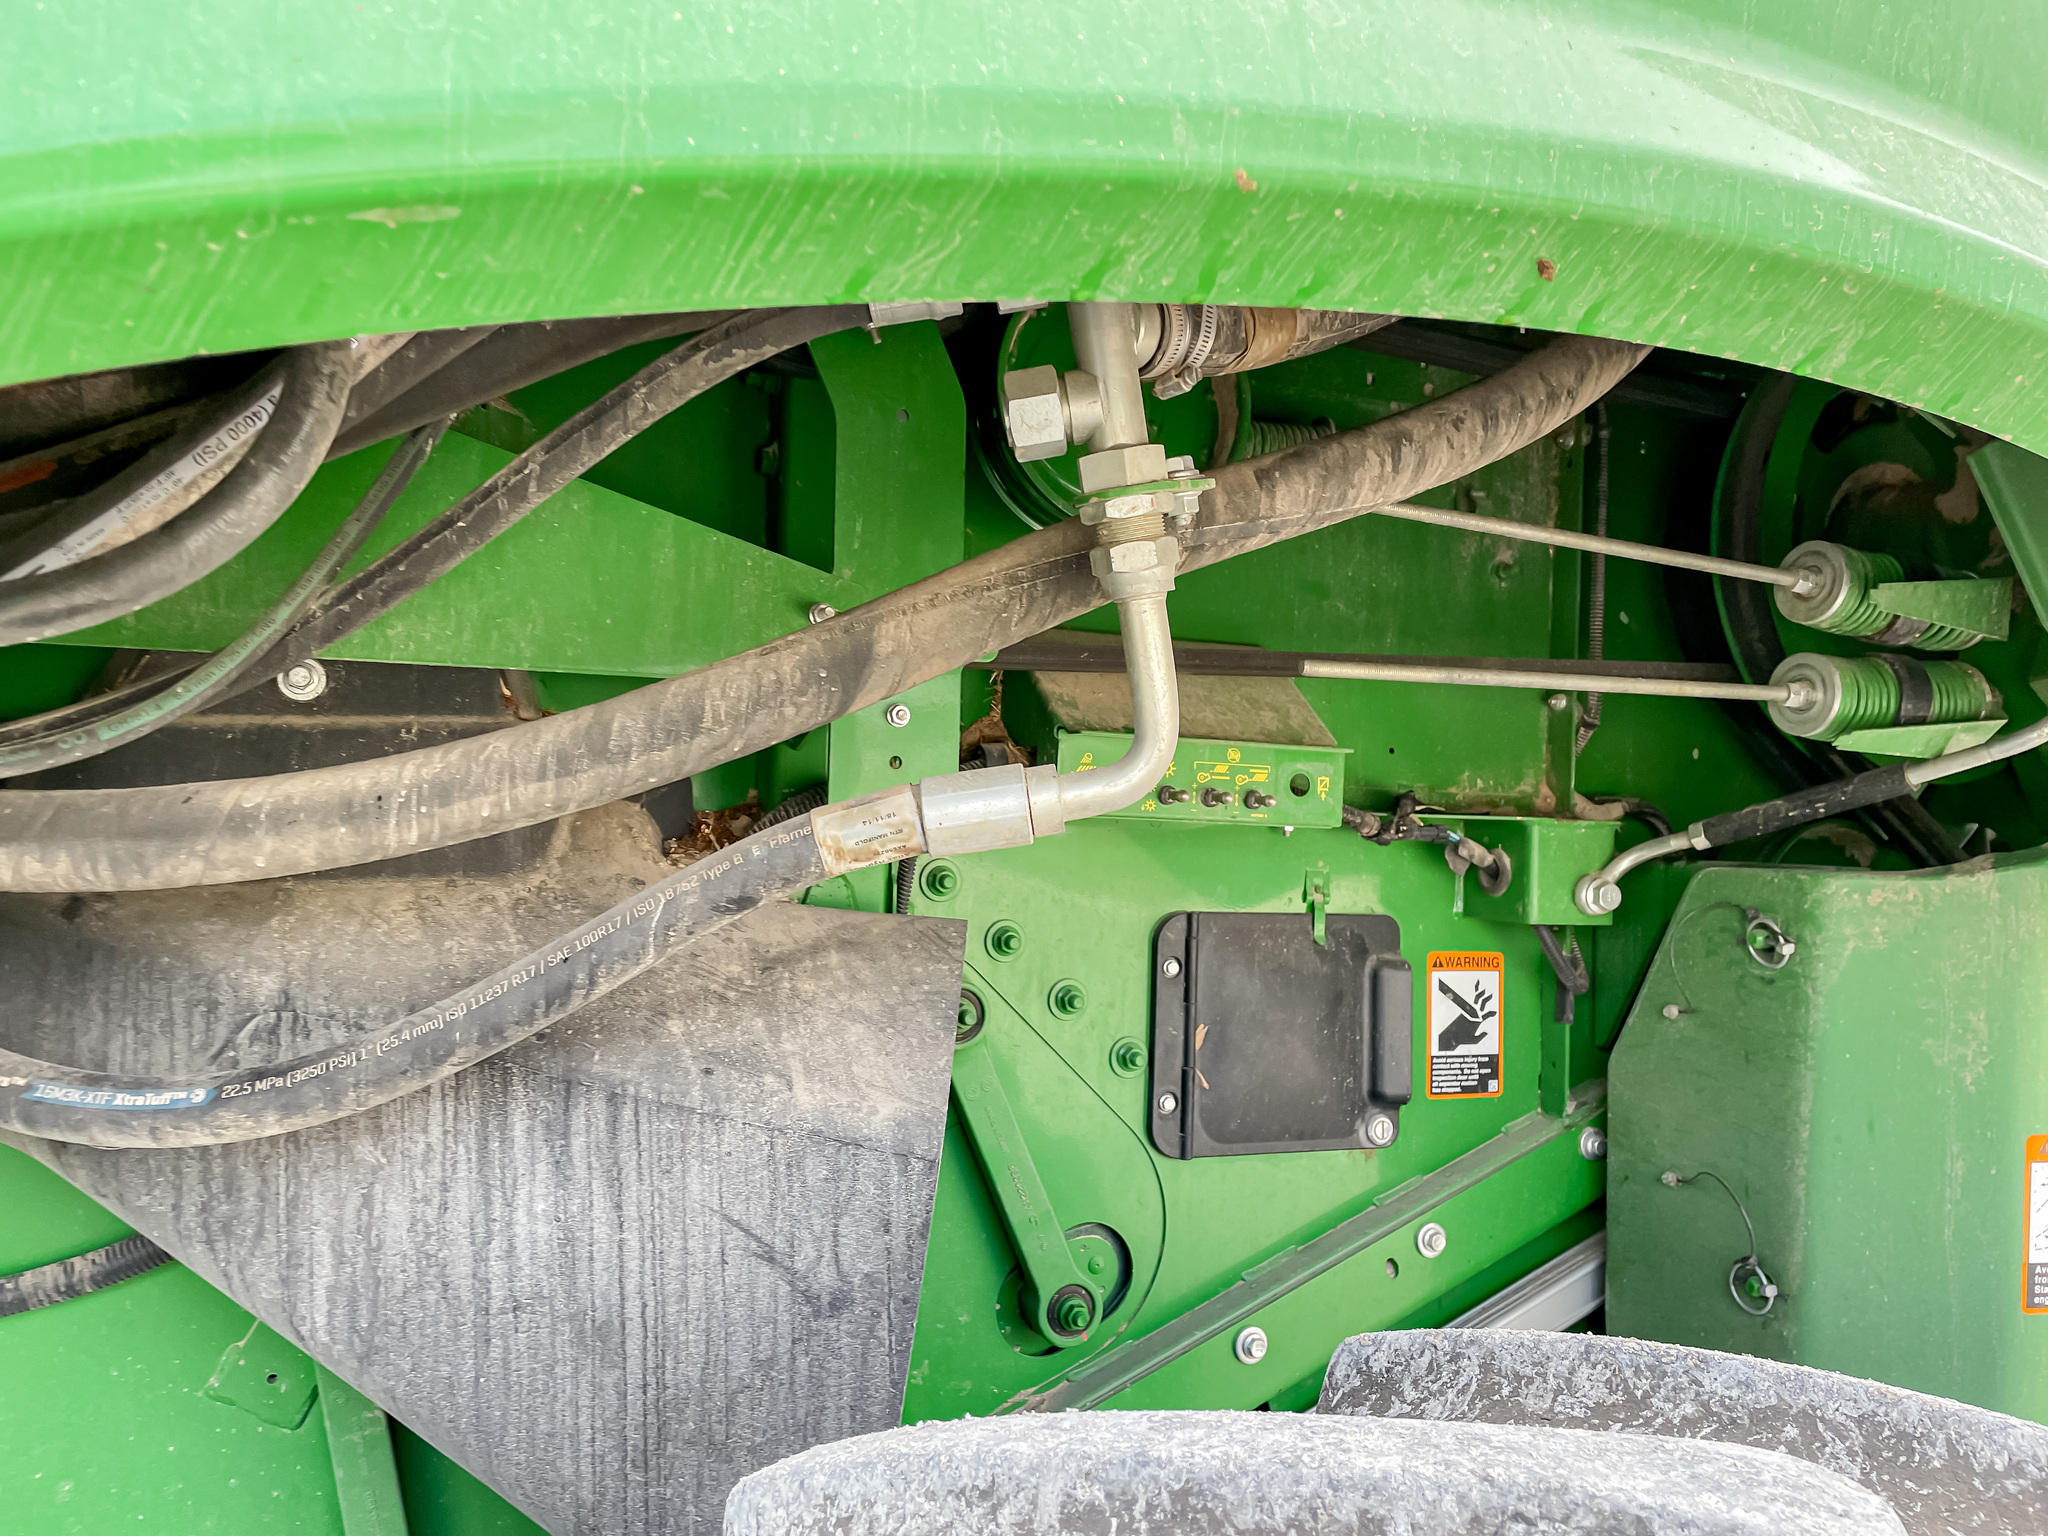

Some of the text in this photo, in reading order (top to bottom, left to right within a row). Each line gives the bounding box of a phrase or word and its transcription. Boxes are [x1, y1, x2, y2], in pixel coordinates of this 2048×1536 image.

[227, 404, 271, 441] (4000
[191, 437, 229, 467] PSI)
[854, 832, 889, 847] MANIFOLD
[221, 1080, 252, 1099] 22.5
[254, 1075, 284, 1093] MPa
[286, 1061, 326, 1088] (3250
[329, 1051, 357, 1072] PSI)
[376, 1029, 411, 1057] (25.4
[412, 1014, 444, 1039] mm)
[445, 1002, 468, 1022] ISO
[469, 981, 509, 1011] 11237
[511, 965, 537, 987] R17
[548, 946, 573, 968] SAE
[575, 916, 623, 953] 100R17
[634, 898, 655, 919] ISO
[656, 874, 700, 904] 18752
[700, 859, 731, 881] Type
[769, 825, 812, 849] Flame
[1445, 956, 1500, 969] WARNING
